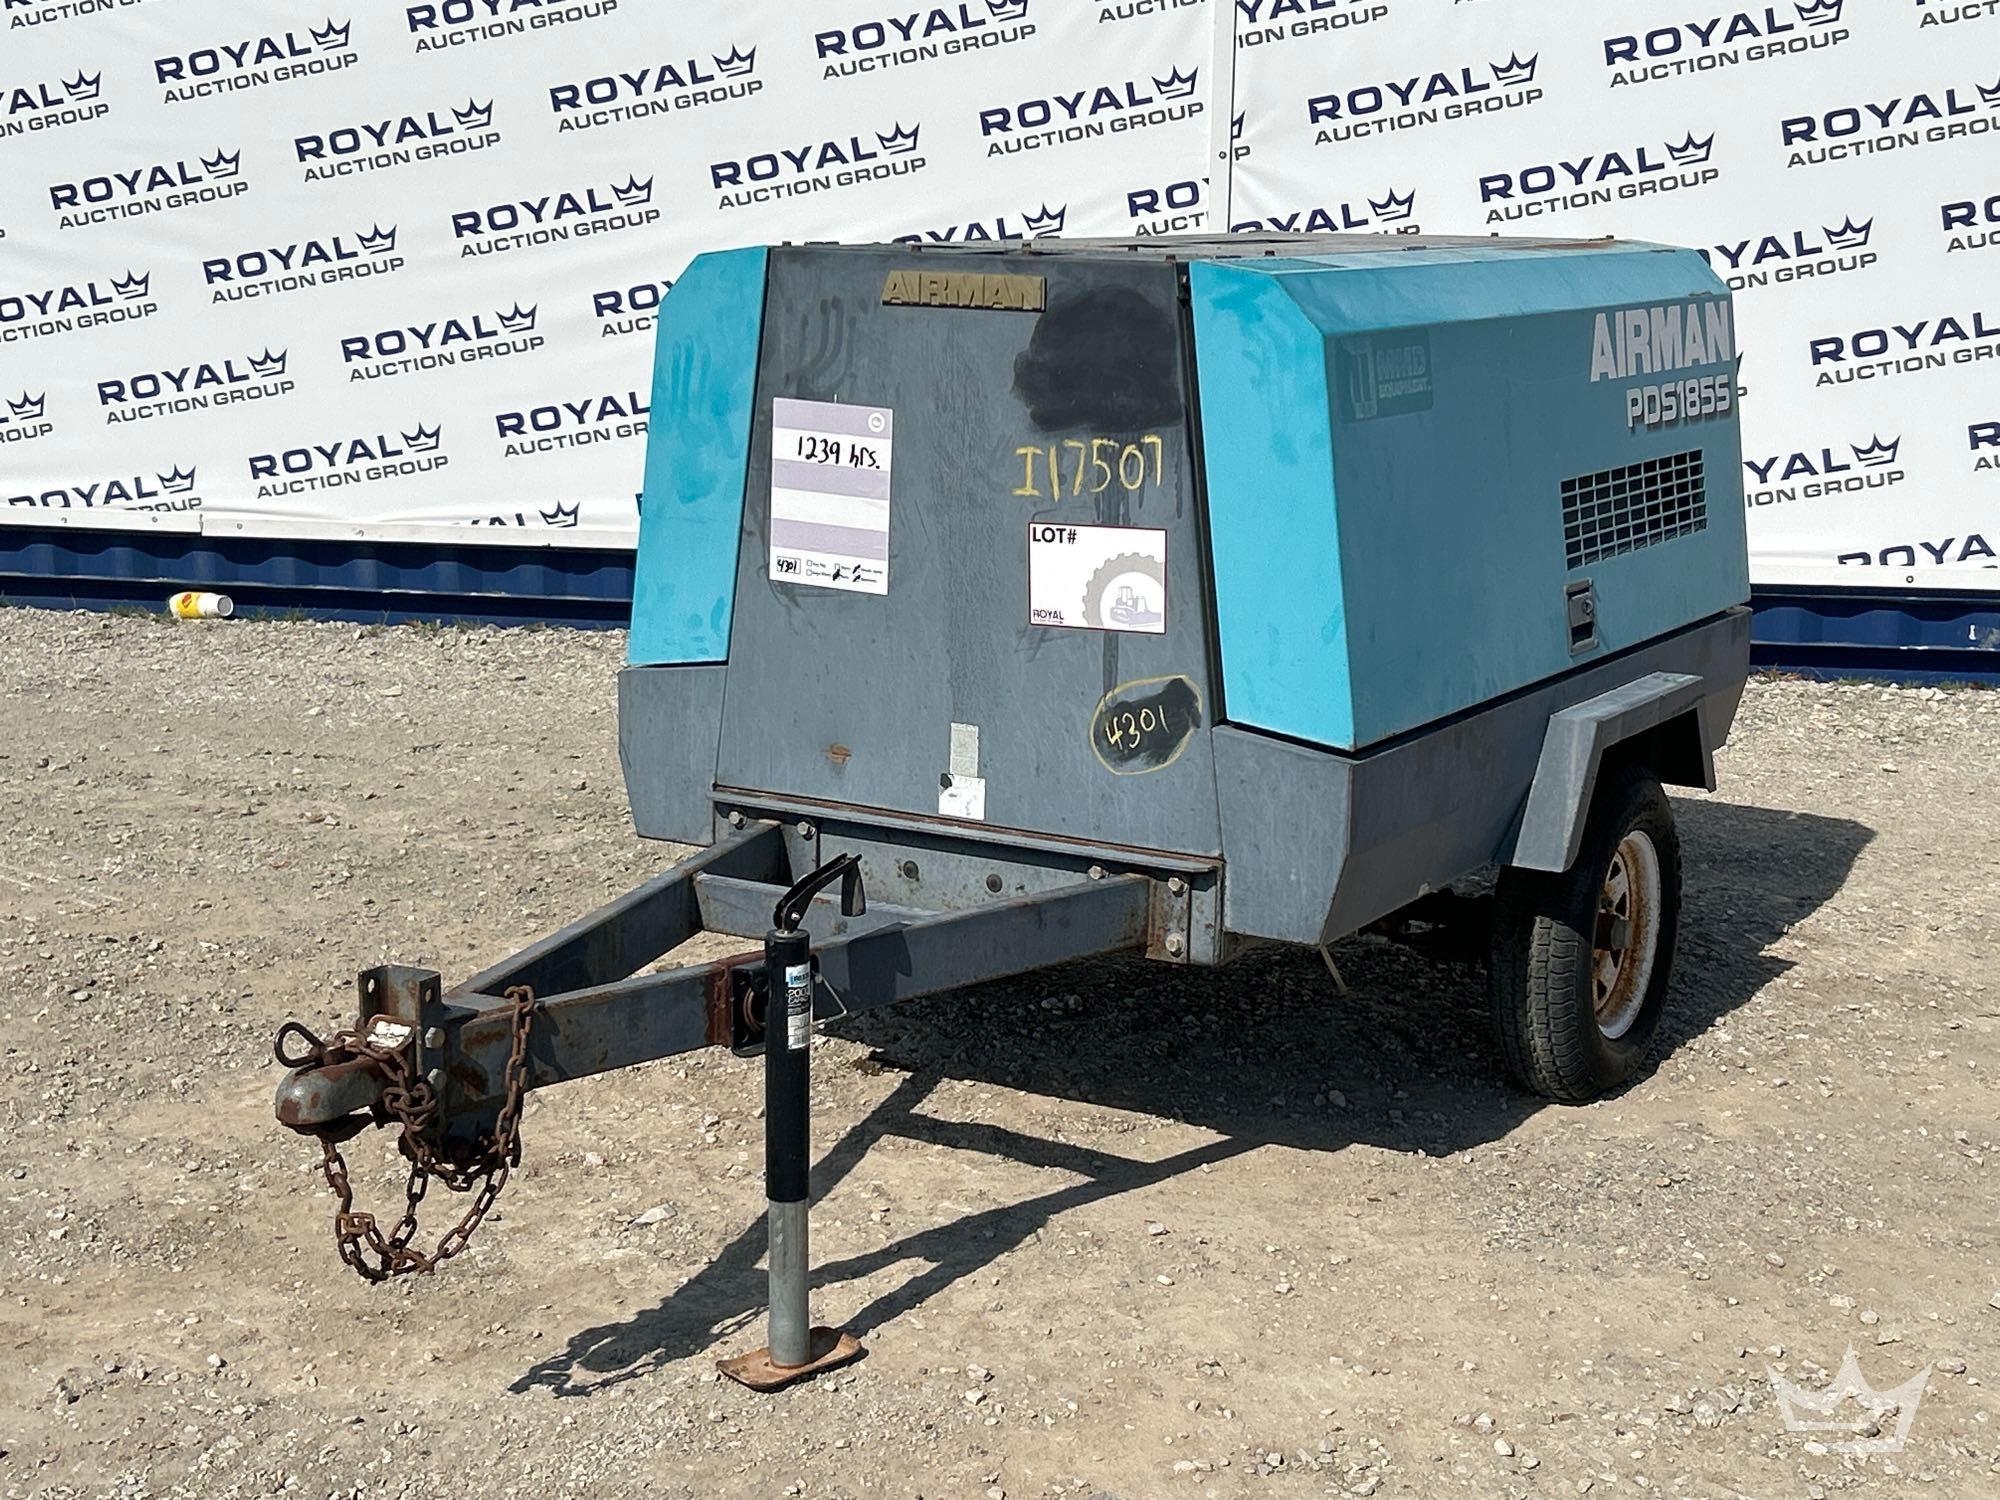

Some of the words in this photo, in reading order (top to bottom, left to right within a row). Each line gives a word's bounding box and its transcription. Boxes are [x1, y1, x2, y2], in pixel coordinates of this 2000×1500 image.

[415, 18, 525, 54] AUCTION
[529, 0, 619, 30] GROUP
[814, 3, 987, 59] ROYAL
[1290, 4, 1389, 38] GROUP
[1603, 7, 1795, 67] ROYAL
[1919, 0, 2000, 29] AUCT
[153, 32, 313, 85] ROYAL
[823, 43, 939, 81] AUCTION
[943, 24, 1036, 55] GROUP
[1609, 49, 1739, 89] AUCTION
[1745, 28, 1850, 62] GROUP
[164, 70, 270, 105] AUCTION
[273, 52, 359, 82] GROUP
[549, 59, 715, 113] ROYAL
[1307, 67, 1491, 125] ROYAL
[28, 103, 110, 131] GROUP
[558, 98, 670, 133] AUCTION
[674, 79, 763, 110] GROUP
[978, 81, 1154, 137] ROYAL
[987, 121, 1105, 158] AUCTION
[1109, 101, 1204, 133] GROUP
[1314, 108, 1438, 146] AUCTION
[1444, 88, 1543, 120] GROUP
[1781, 88, 1976, 147] ROYAL
[294, 111, 455, 163] ROYAL
[304, 149, 411, 183] AUCTION
[415, 132, 501, 161] GROUP
[1787, 130, 1919, 169] AUCTION
[49, 160, 204, 211] ROYAL
[710, 136, 878, 190] ROYAL
[718, 175, 831, 210] AUCTION
[836, 157, 926, 187] GROUP
[1478, 146, 1666, 204] ROYAL
[59, 197, 162, 230] AUCTION
[165, 181, 249, 209] GROUP
[451, 188, 614, 239] ROYAL
[1485, 187, 1612, 225] AUCTION
[1618, 168, 1719, 199] GROUP
[460, 226, 569, 259] AUCTION
[573, 208, 661, 237] GROUP
[1135, 211, 1209, 237] AUCT
[202, 236, 359, 285] ROYAL
[212, 273, 317, 304] AUCTION
[320, 257, 405, 284] GROUP
[1774, 252, 1878, 283] GROUP
[0, 282, 114, 323] OYAL
[881, 269, 1047, 312] AIRMAN
[2, 318, 73, 342] CTION
[76, 302, 158, 329] GROUP
[340, 315, 499, 363] ROYAL
[1589, 300, 1731, 383] AIRMAN
[1810, 312, 2000, 366] ROYAL
[97, 359, 250, 406] ROYAL
[350, 351, 456, 383] AUCTION
[460, 336, 545, 363] GROUP
[1815, 352, 1946, 388] AUCTION
[106, 395, 209, 425] AUCTION
[213, 380, 295, 406] GROUP
[493, 391, 652, 436] ROYAL
[248, 434, 404, 480] ROYAL
[504, 427, 611, 458] AUCTION
[797, 435, 841, 465] 1239
[848, 443, 881, 470] hrs.
[1742, 447, 1851, 485] YAL
[257, 470, 362, 499] AUCTION
[365, 455, 449, 481] GROUP
[1803, 470, 1905, 498] GROUP
[1032, 526, 1077, 545] LOT#
[1032, 608, 1065, 621] ROYAL
[1105, 704, 1170, 751] 4301
